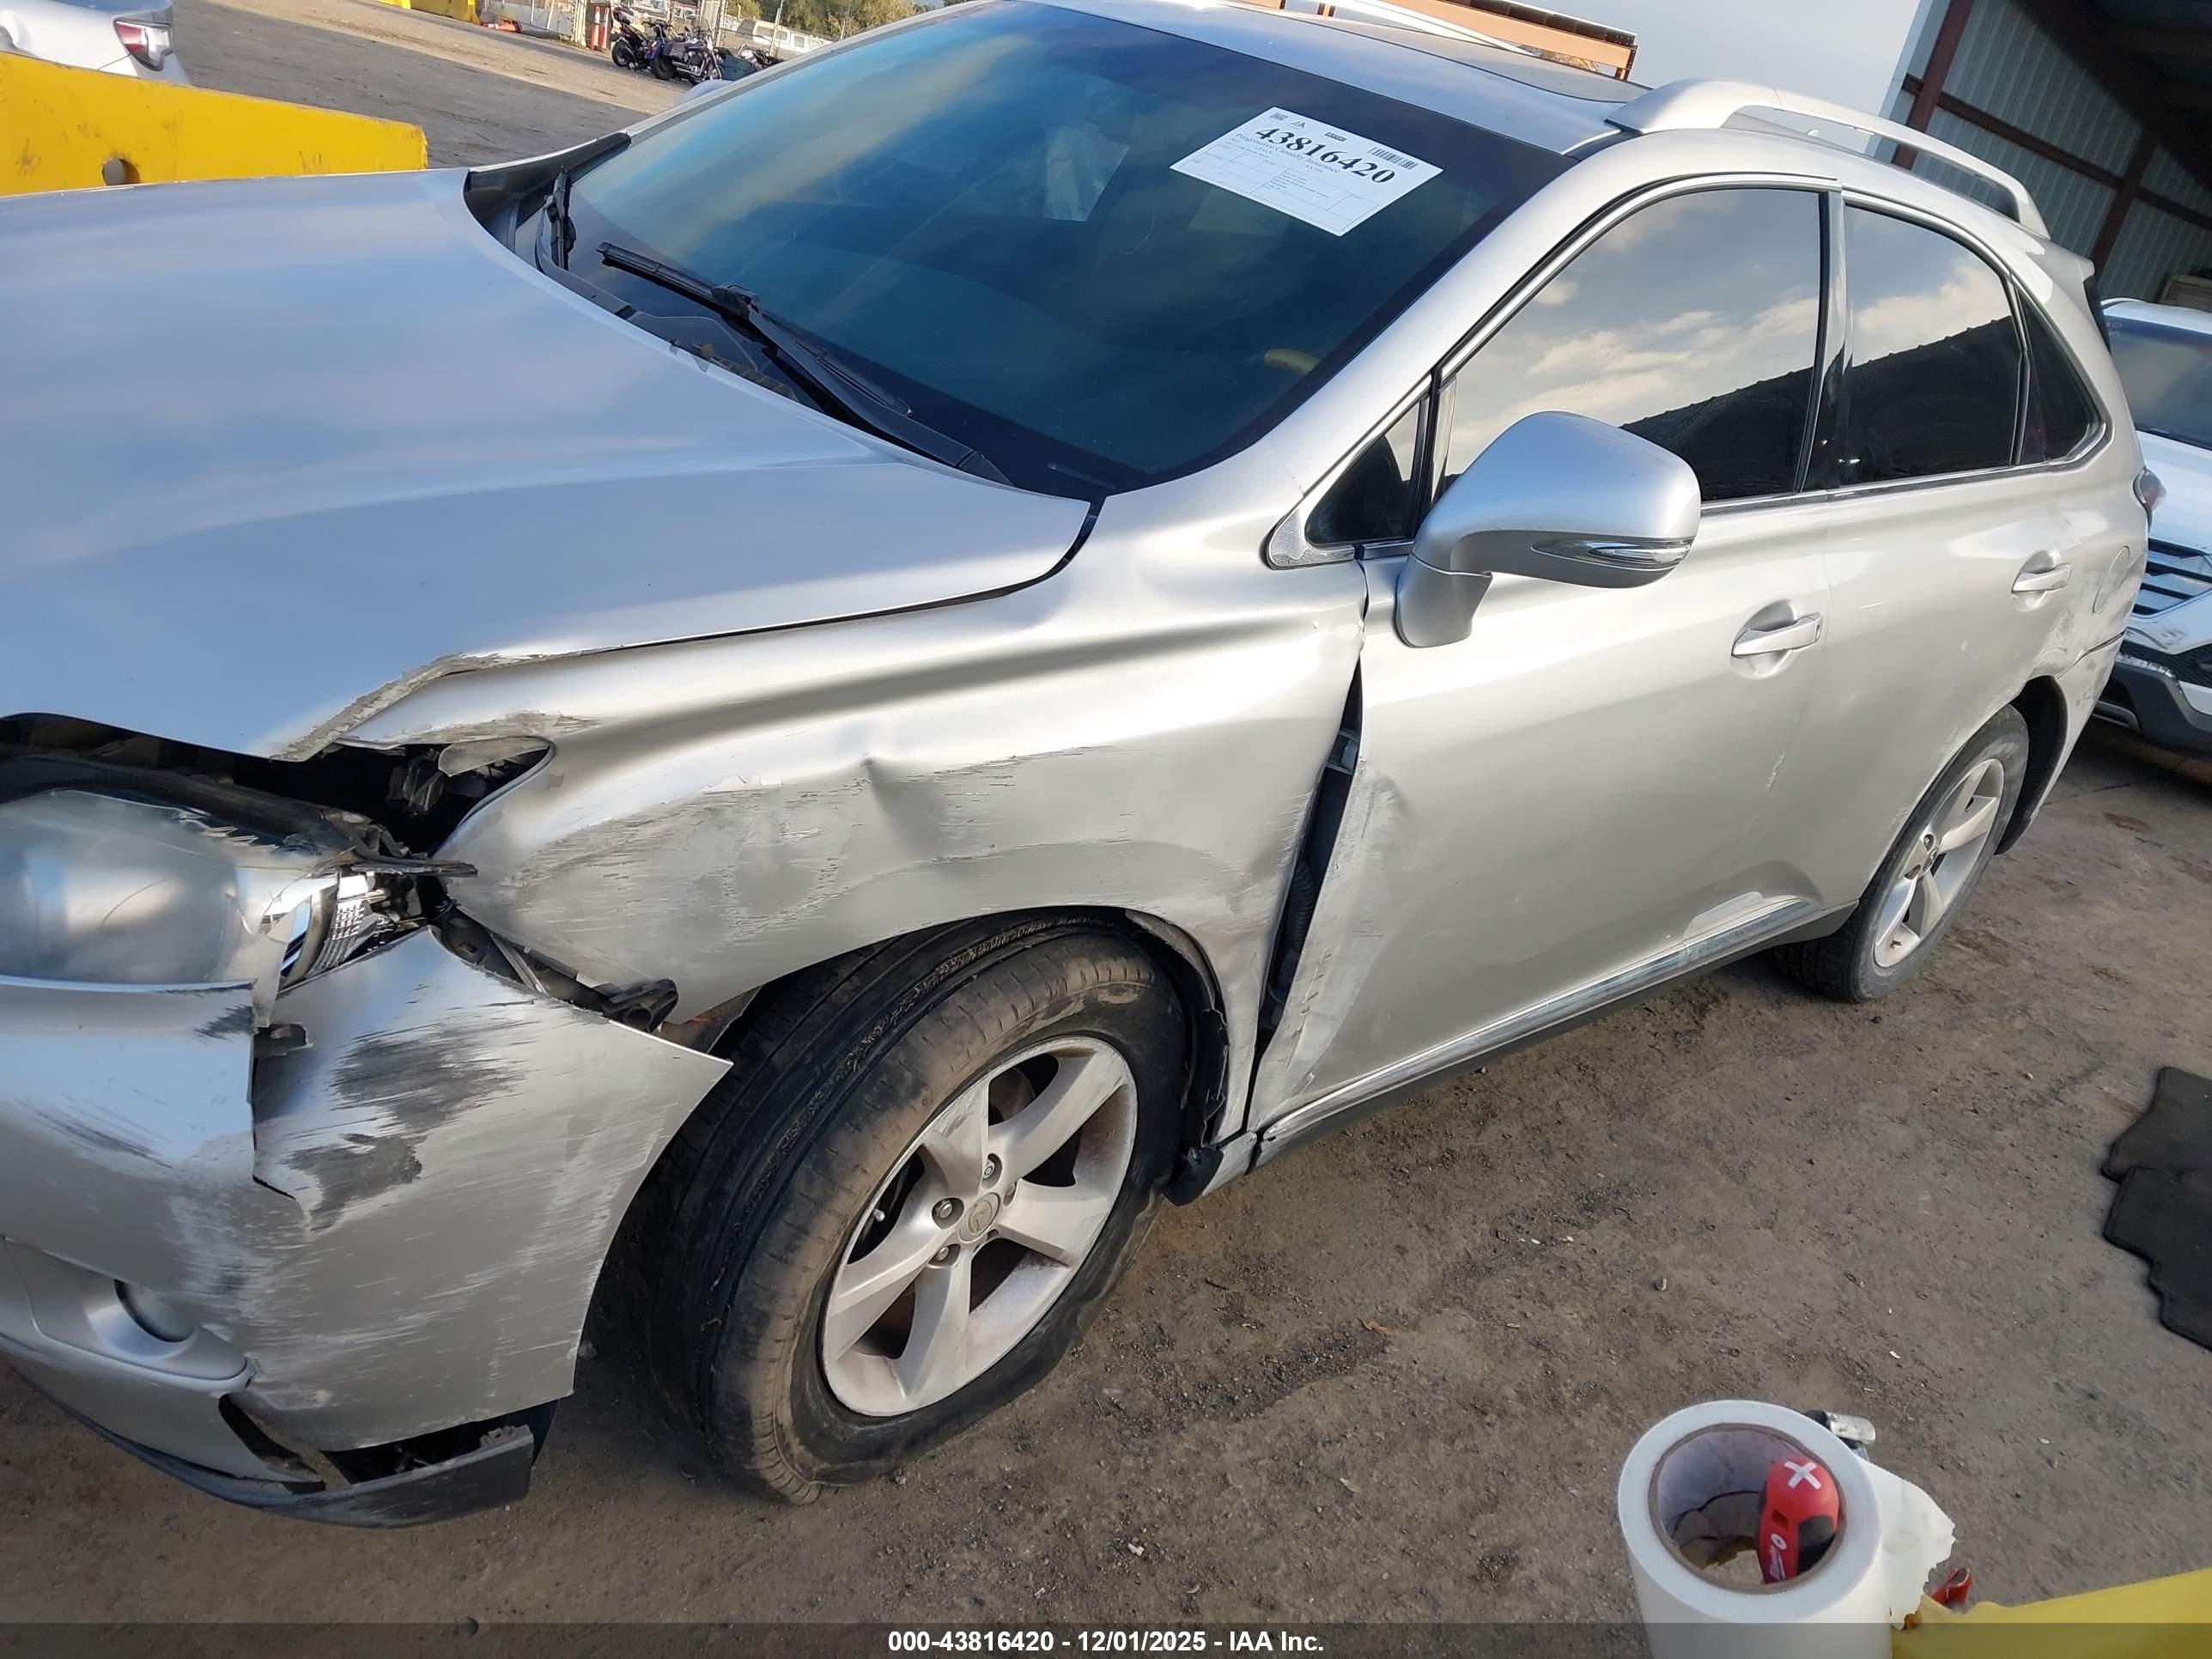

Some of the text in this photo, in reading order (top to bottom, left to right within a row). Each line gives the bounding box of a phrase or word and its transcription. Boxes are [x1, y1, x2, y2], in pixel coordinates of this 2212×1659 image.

[1235, 133, 1273, 149] Progressive
[1274, 147, 1305, 161] Casualty
[1305, 158, 1340, 173] Insurance
[1255, 128, 1395, 184] 43816420
